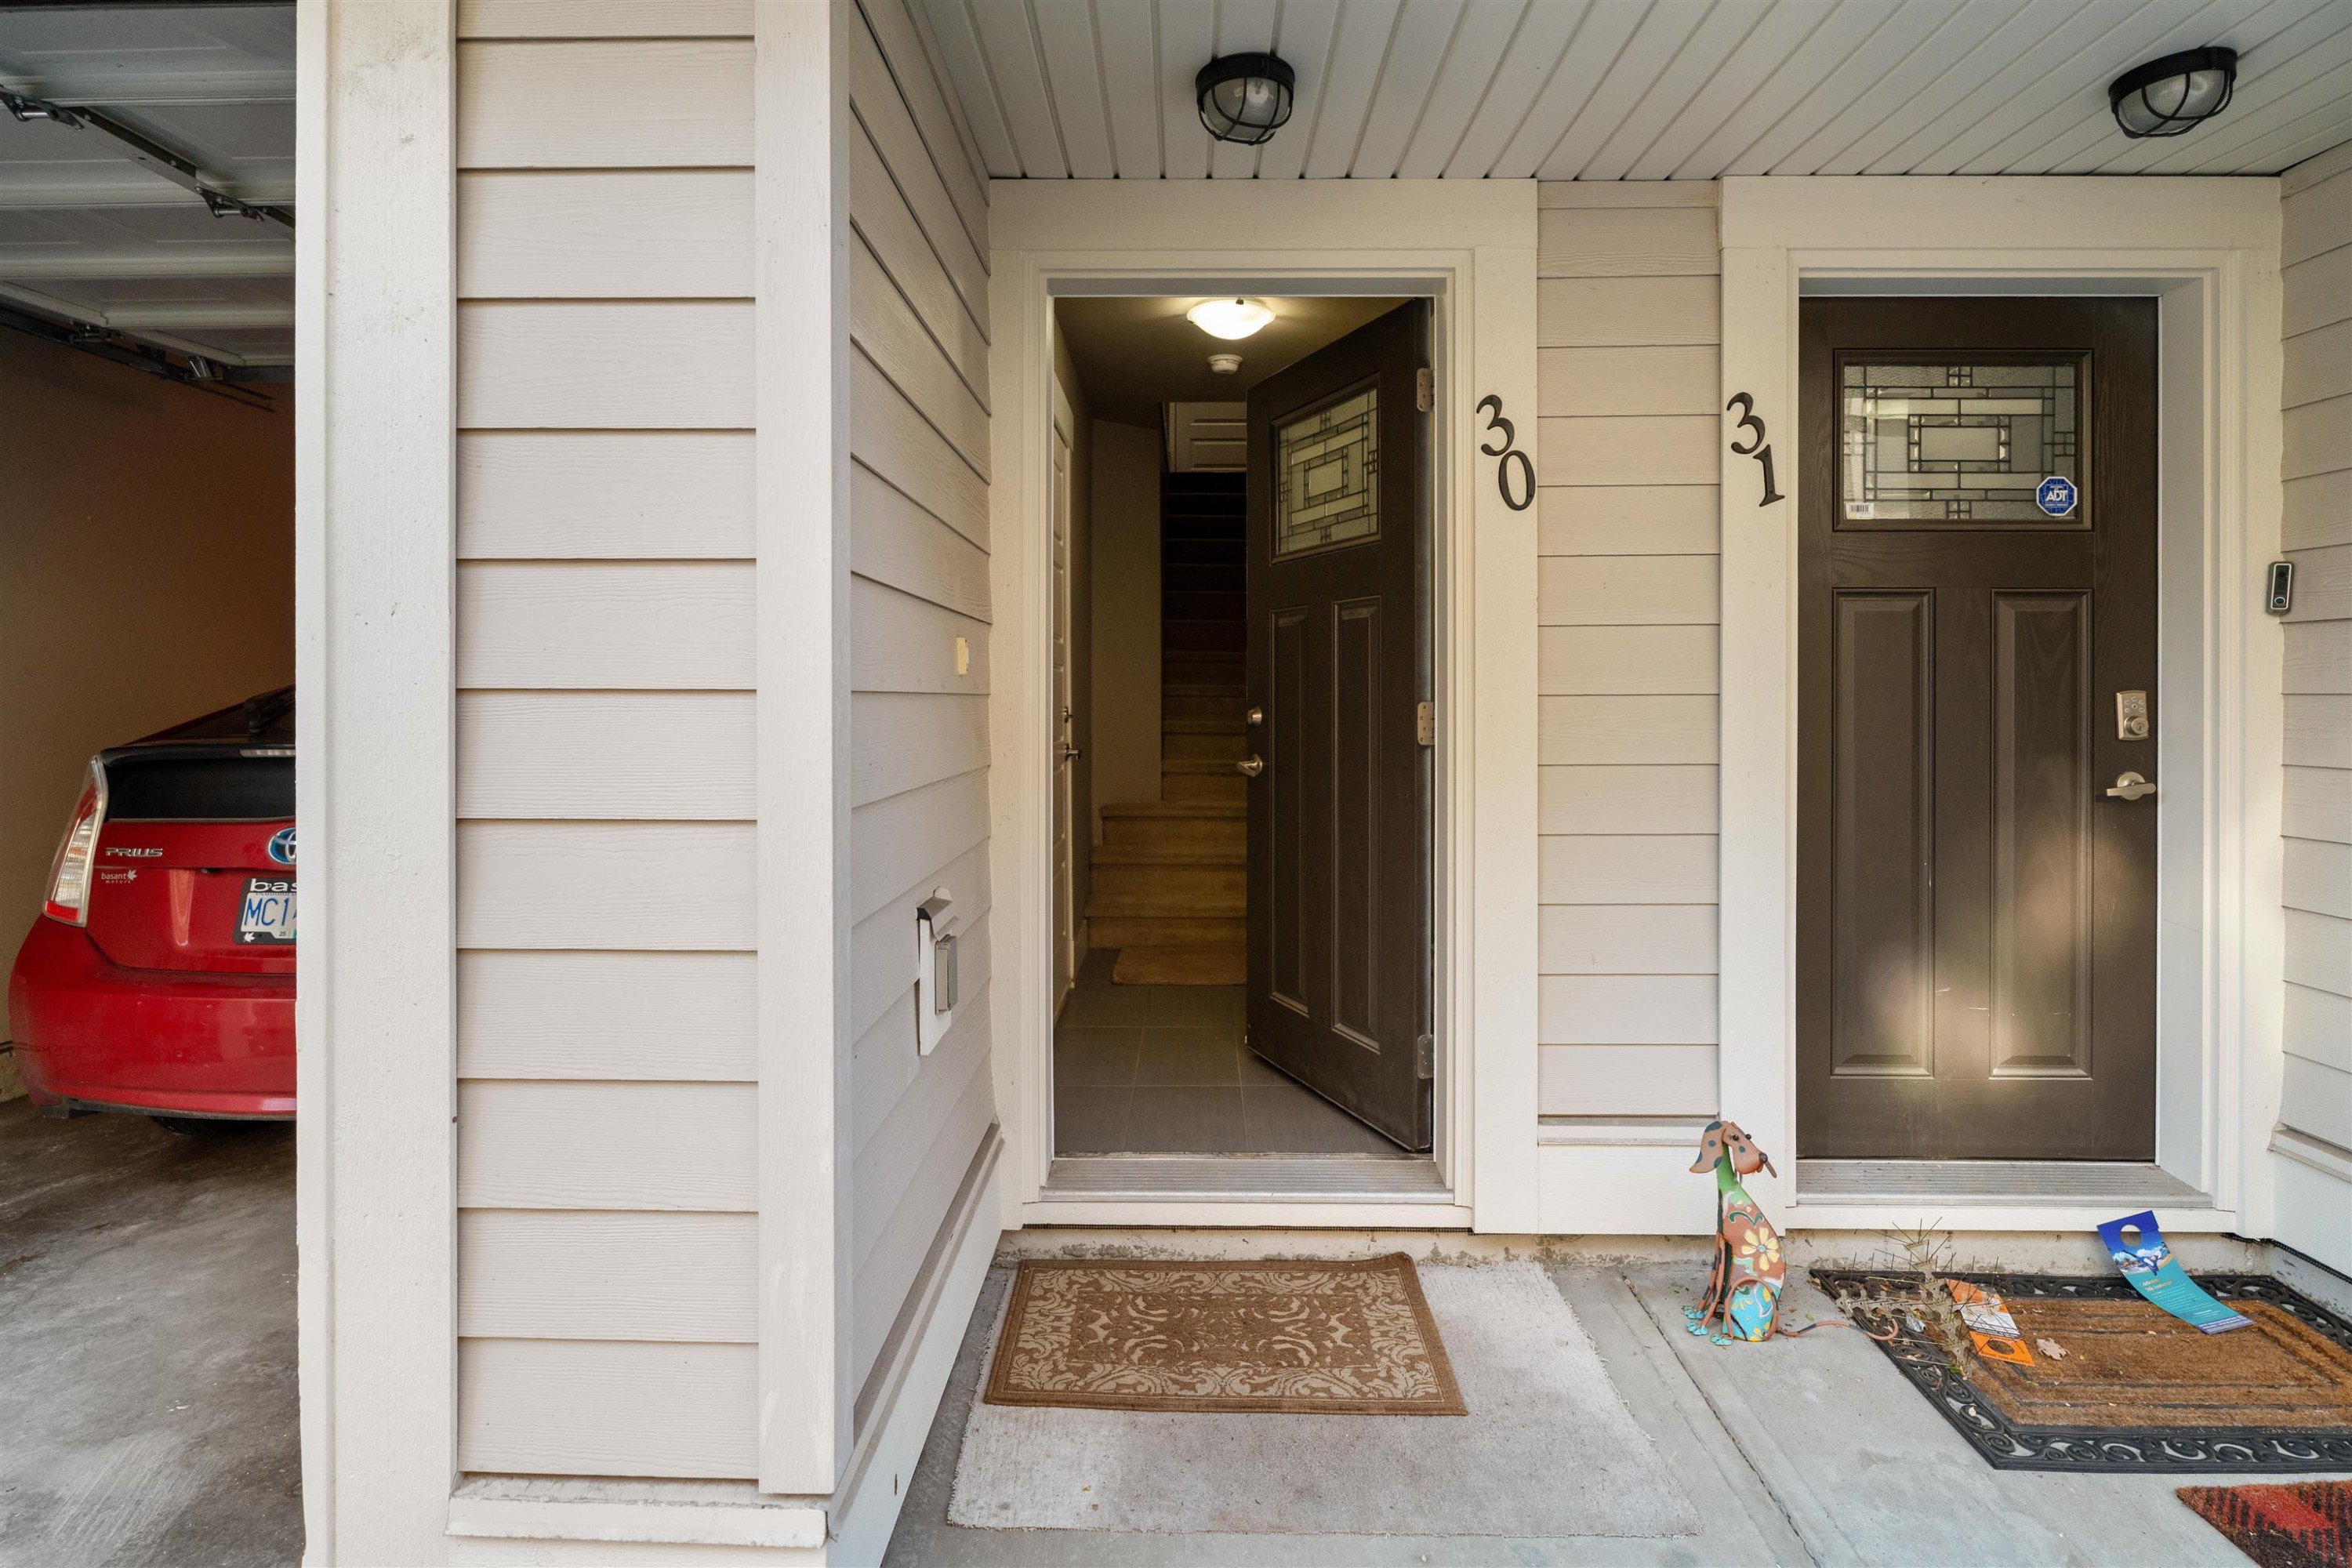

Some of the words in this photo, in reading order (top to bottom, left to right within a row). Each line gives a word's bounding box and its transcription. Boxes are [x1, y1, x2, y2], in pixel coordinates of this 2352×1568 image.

[1476, 394, 1536, 511] 30
[1726, 392, 1785, 507] 31
[2045, 490, 2068, 502] ADT
[105, 848, 163, 858] PRIUS
[244, 898, 297, 927] MC1
